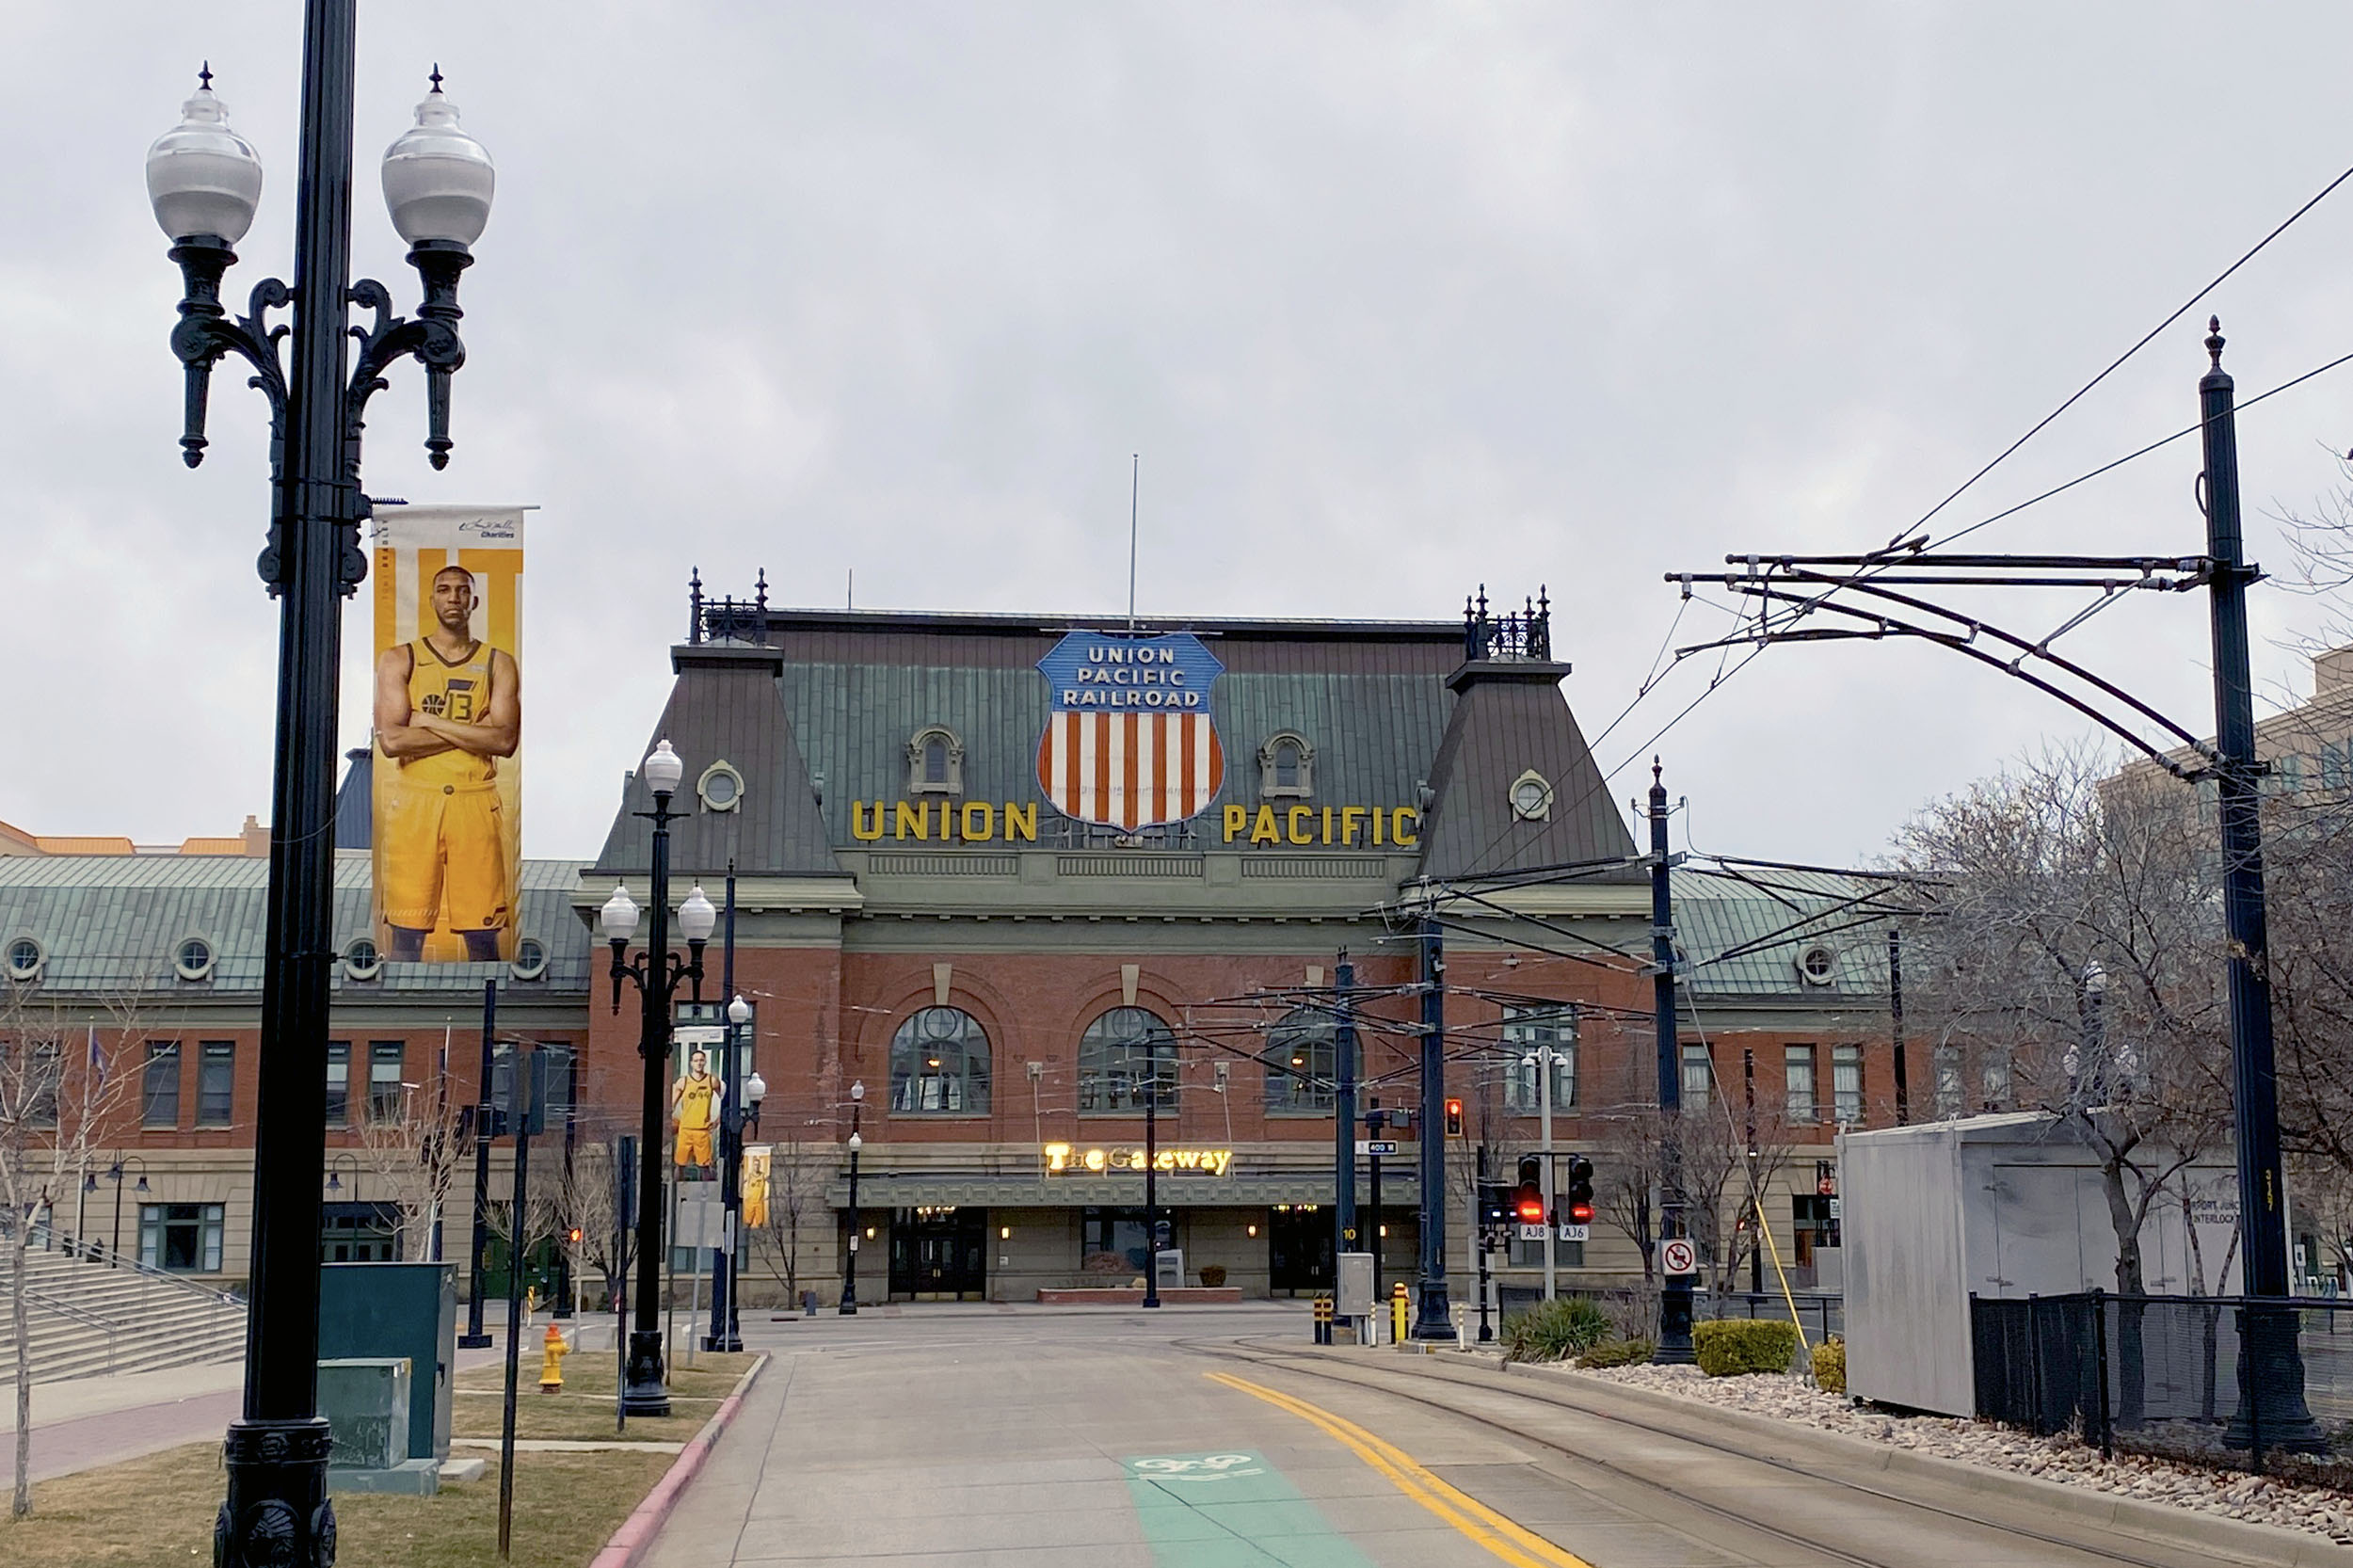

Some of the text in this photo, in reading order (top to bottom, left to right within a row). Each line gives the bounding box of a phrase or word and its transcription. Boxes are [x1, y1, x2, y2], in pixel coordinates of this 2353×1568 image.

[1089, 648, 1174, 664] UNION
[1078, 667, 1185, 686] PACIFIC
[1063, 690, 1199, 707] RAILROAD
[447, 693, 472, 721] 13
[853, 800, 1417, 846] UNION PACIFIC
[1370, 1144, 1385, 1152] 400
[1045, 1142, 1105, 1171] The
[1343, 1228, 1356, 1240] 10
[1526, 1226, 1545, 1238] AJ8
[1564, 1227, 1584, 1239] AJ6
